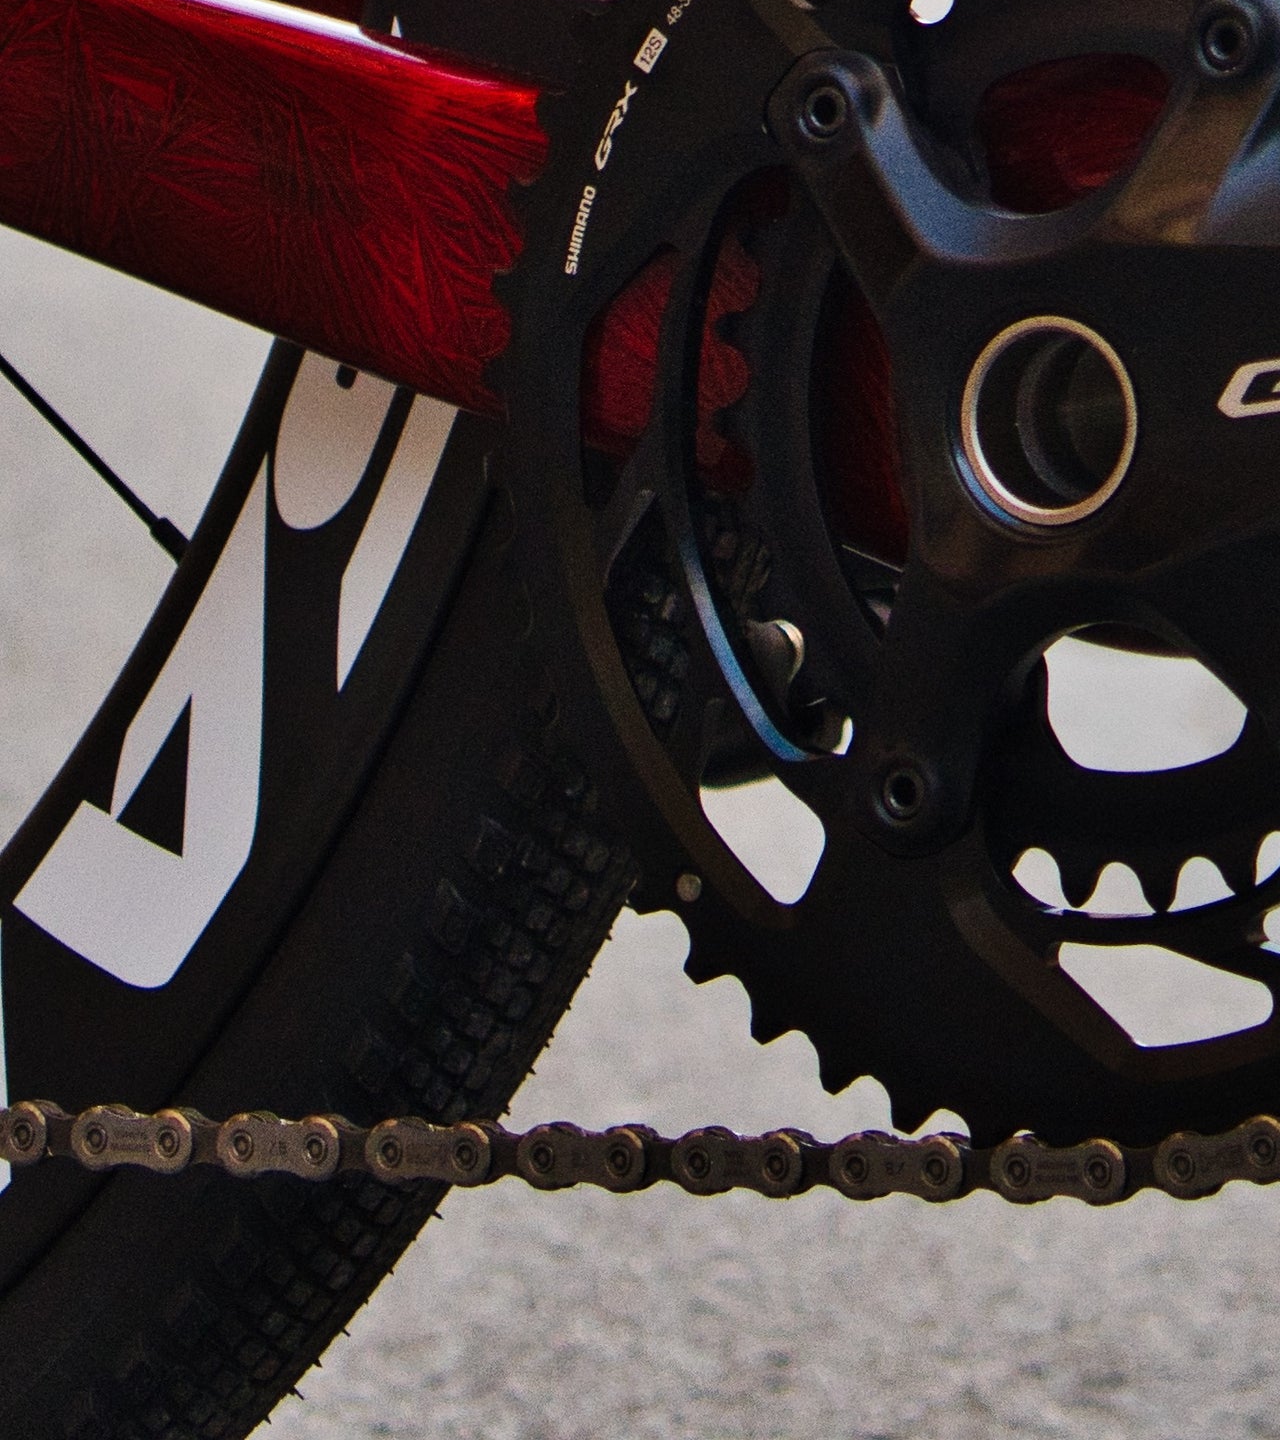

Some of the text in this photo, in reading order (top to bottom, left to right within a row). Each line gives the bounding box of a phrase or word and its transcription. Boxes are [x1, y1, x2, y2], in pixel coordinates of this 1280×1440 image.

[565, 186, 596, 275] SHIMANO
[594, 81, 638, 170] GRX
[638, 35, 664, 66] 12S
